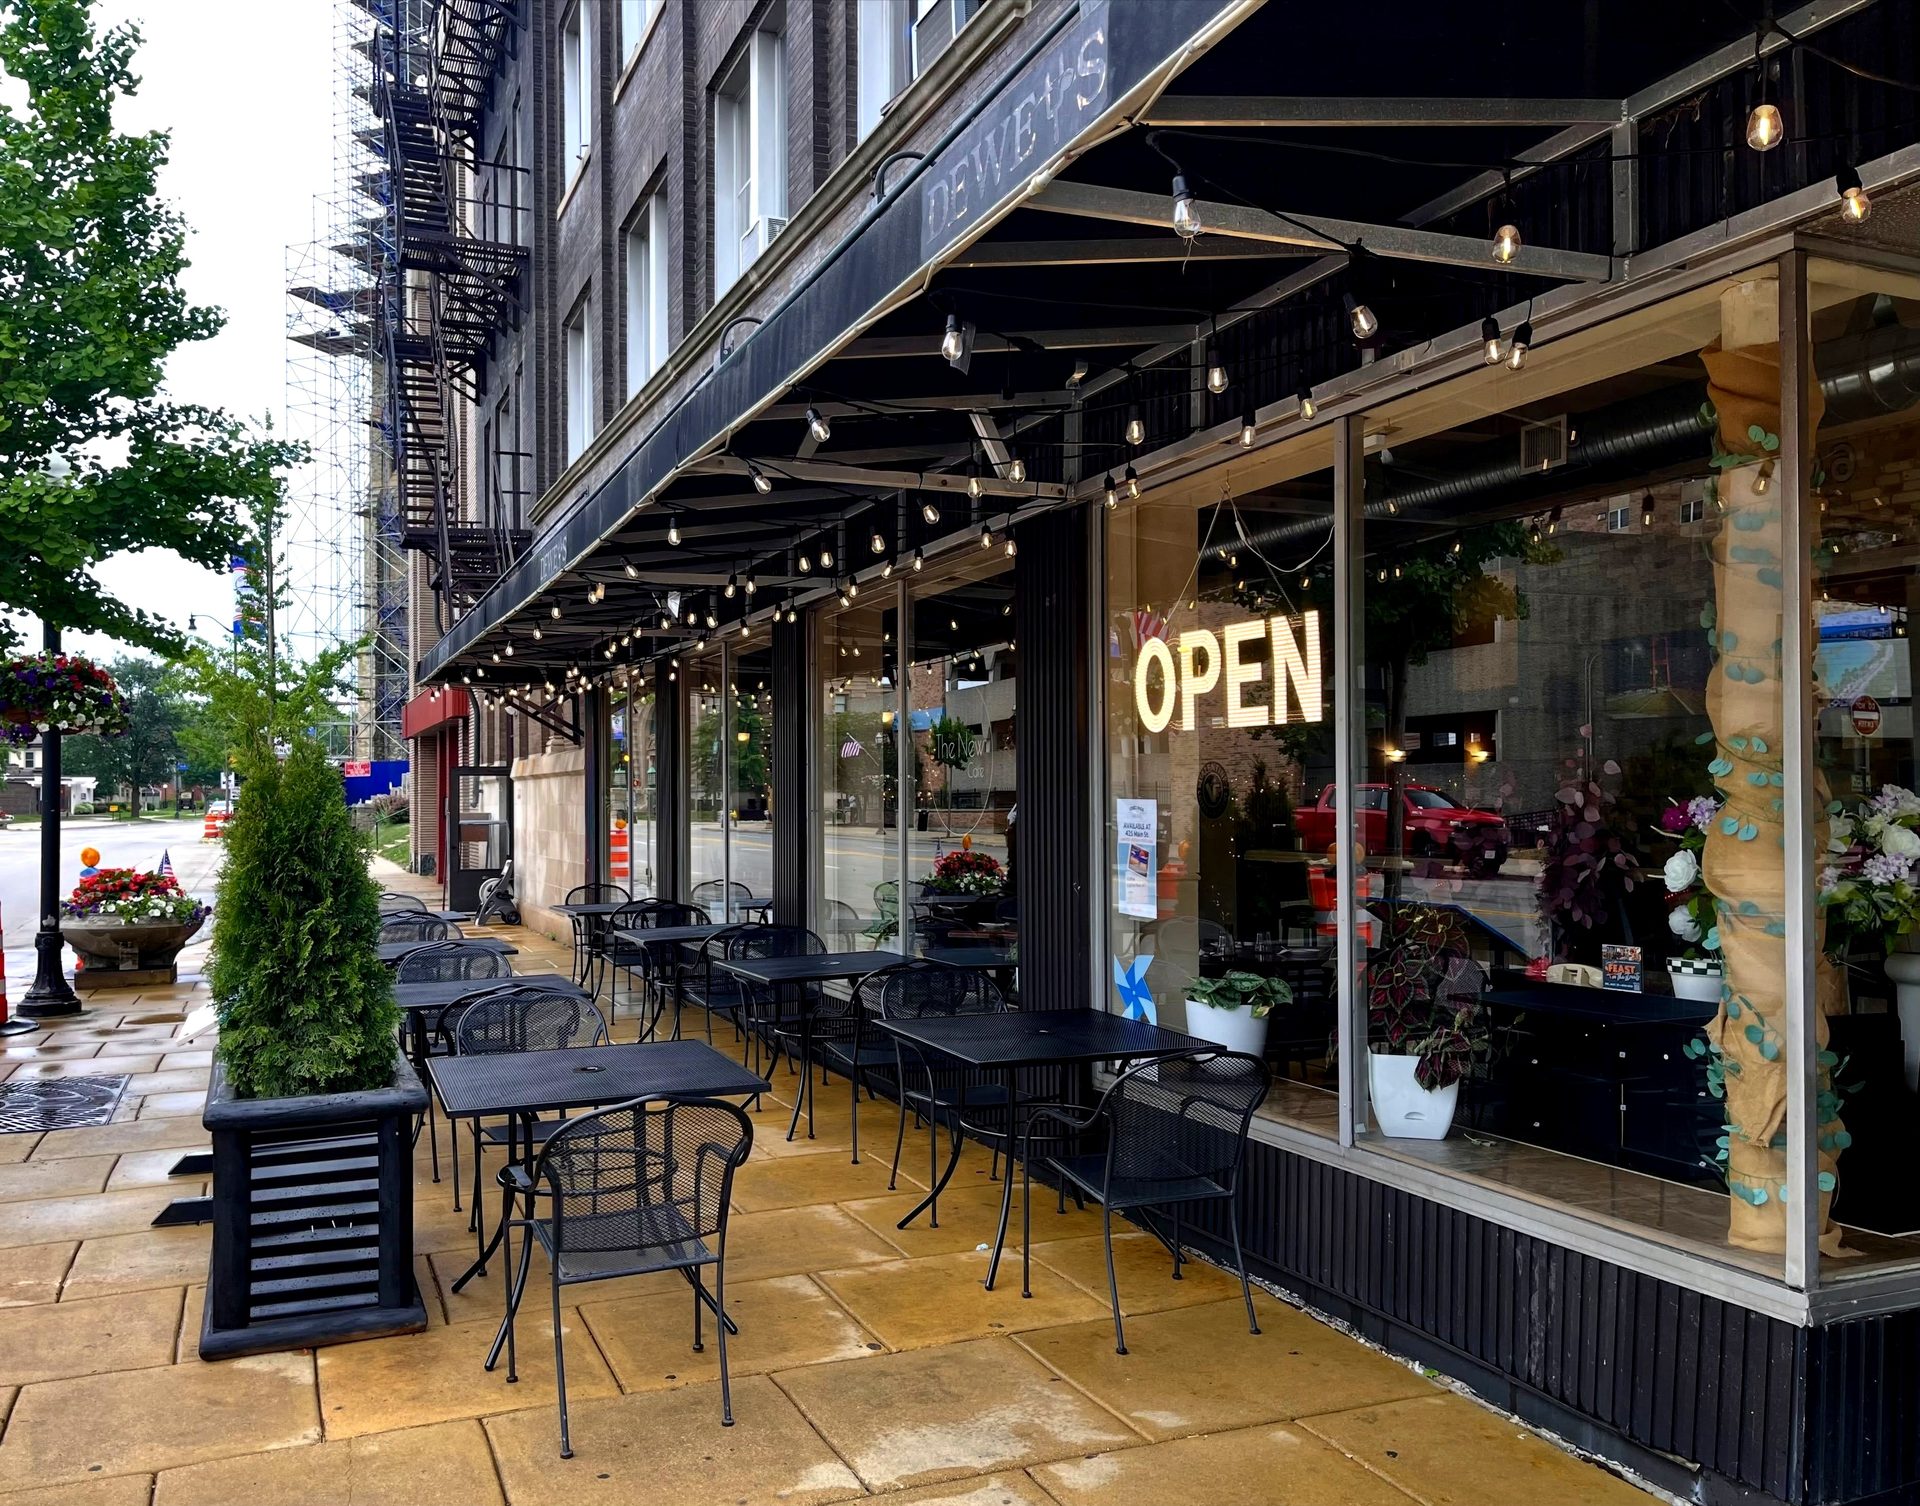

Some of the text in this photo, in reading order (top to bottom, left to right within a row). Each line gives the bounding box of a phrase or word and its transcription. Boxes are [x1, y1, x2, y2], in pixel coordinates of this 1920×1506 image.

[1135, 610, 1322, 733] OPEN
[935, 731, 986, 759] The New
[1607, 963, 1635, 974] FEAST
